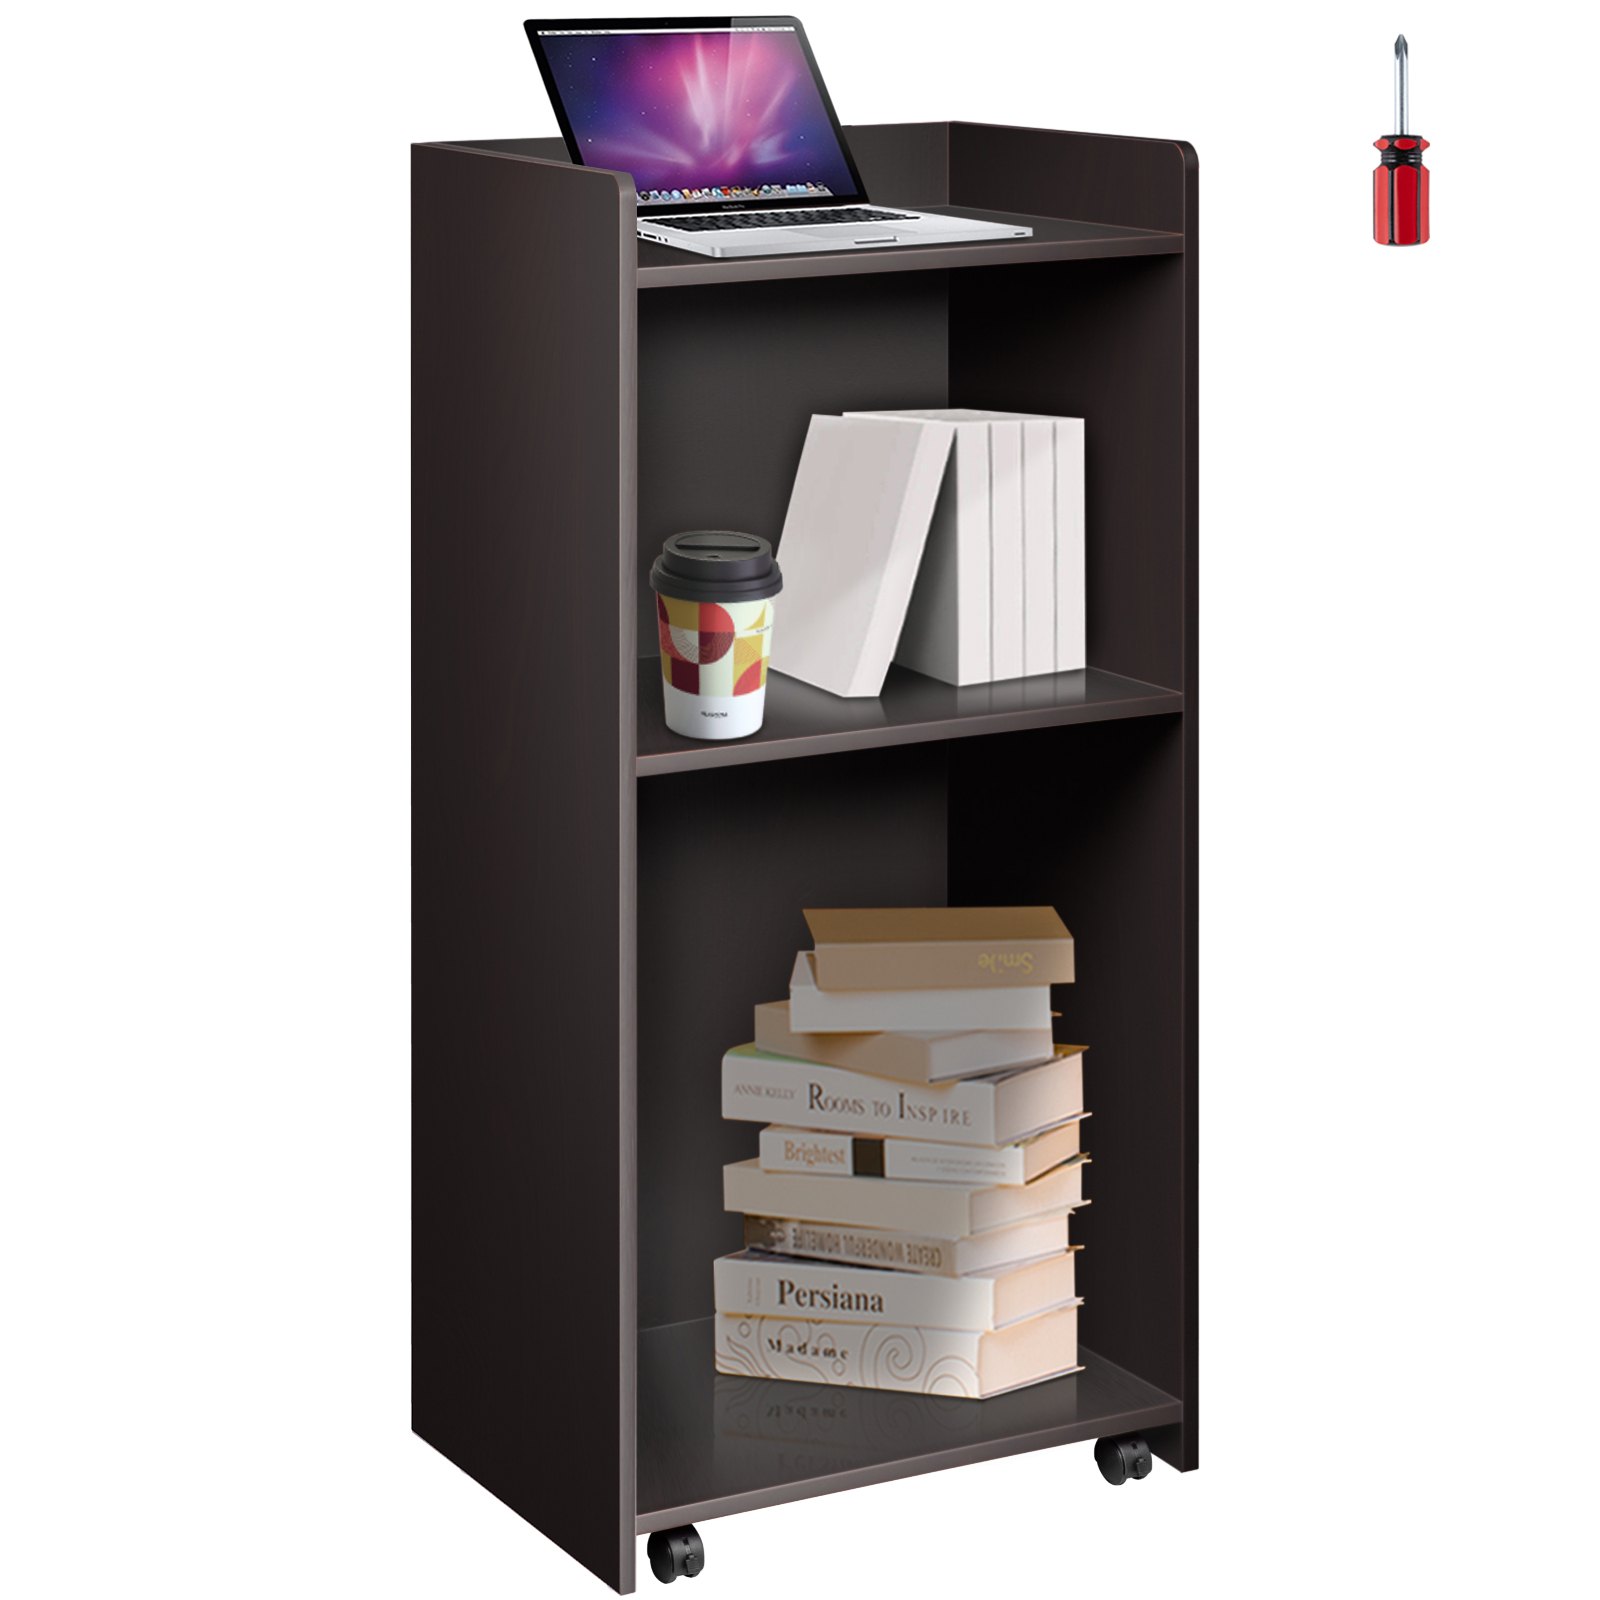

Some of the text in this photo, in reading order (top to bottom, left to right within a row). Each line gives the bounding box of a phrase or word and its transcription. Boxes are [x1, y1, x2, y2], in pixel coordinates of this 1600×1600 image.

[978, 952, 1034, 975] Smile
[783, 1140, 847, 1168] Brightest
[842, 1234, 904, 1263] WONDERFUL
[905, 1244, 942, 1269] CREATE
[776, 1278, 885, 1314] Persiana
[767, 1337, 849, 1361] Madame
